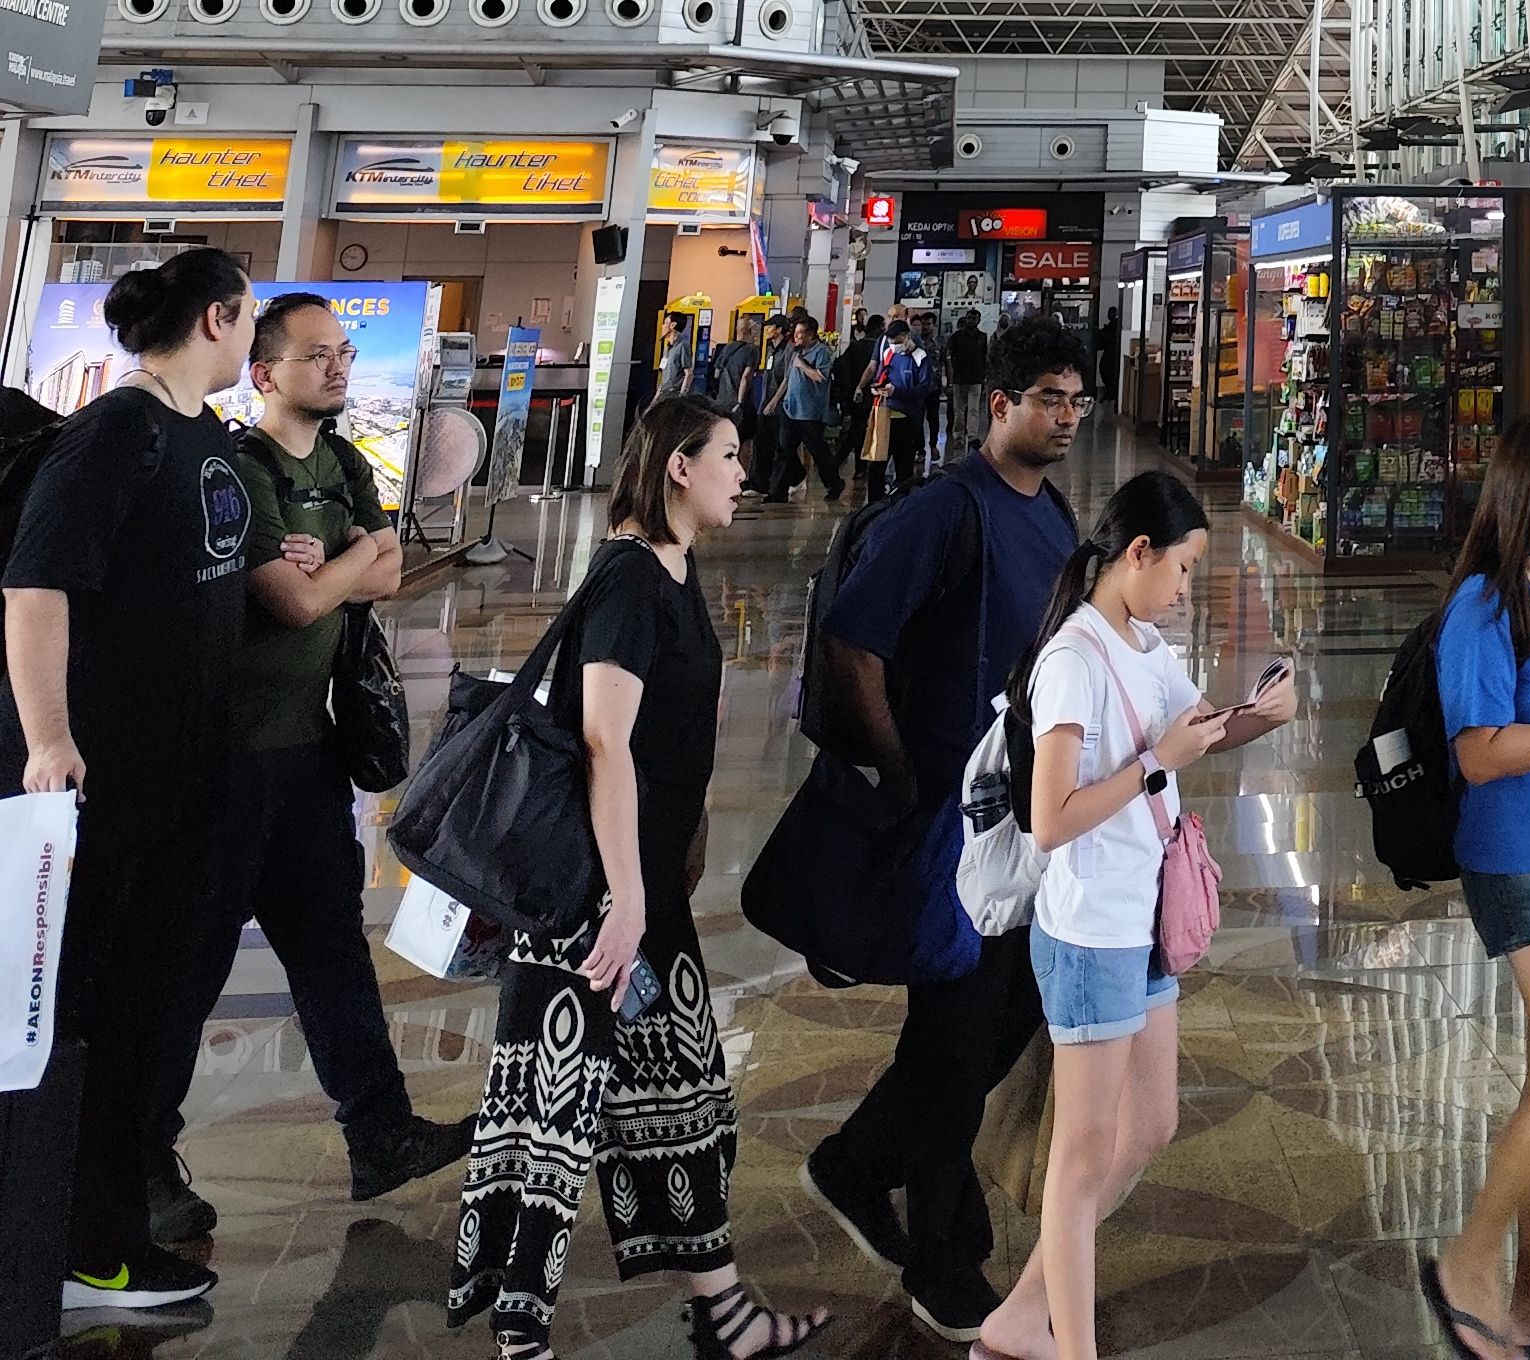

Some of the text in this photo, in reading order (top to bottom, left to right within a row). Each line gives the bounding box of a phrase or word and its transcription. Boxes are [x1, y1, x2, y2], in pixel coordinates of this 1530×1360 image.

[907, 223, 931, 232] KEDAI
[1018, 252, 1090, 268] SALE
[26, 841, 53, 1044] #AEONResponsible
